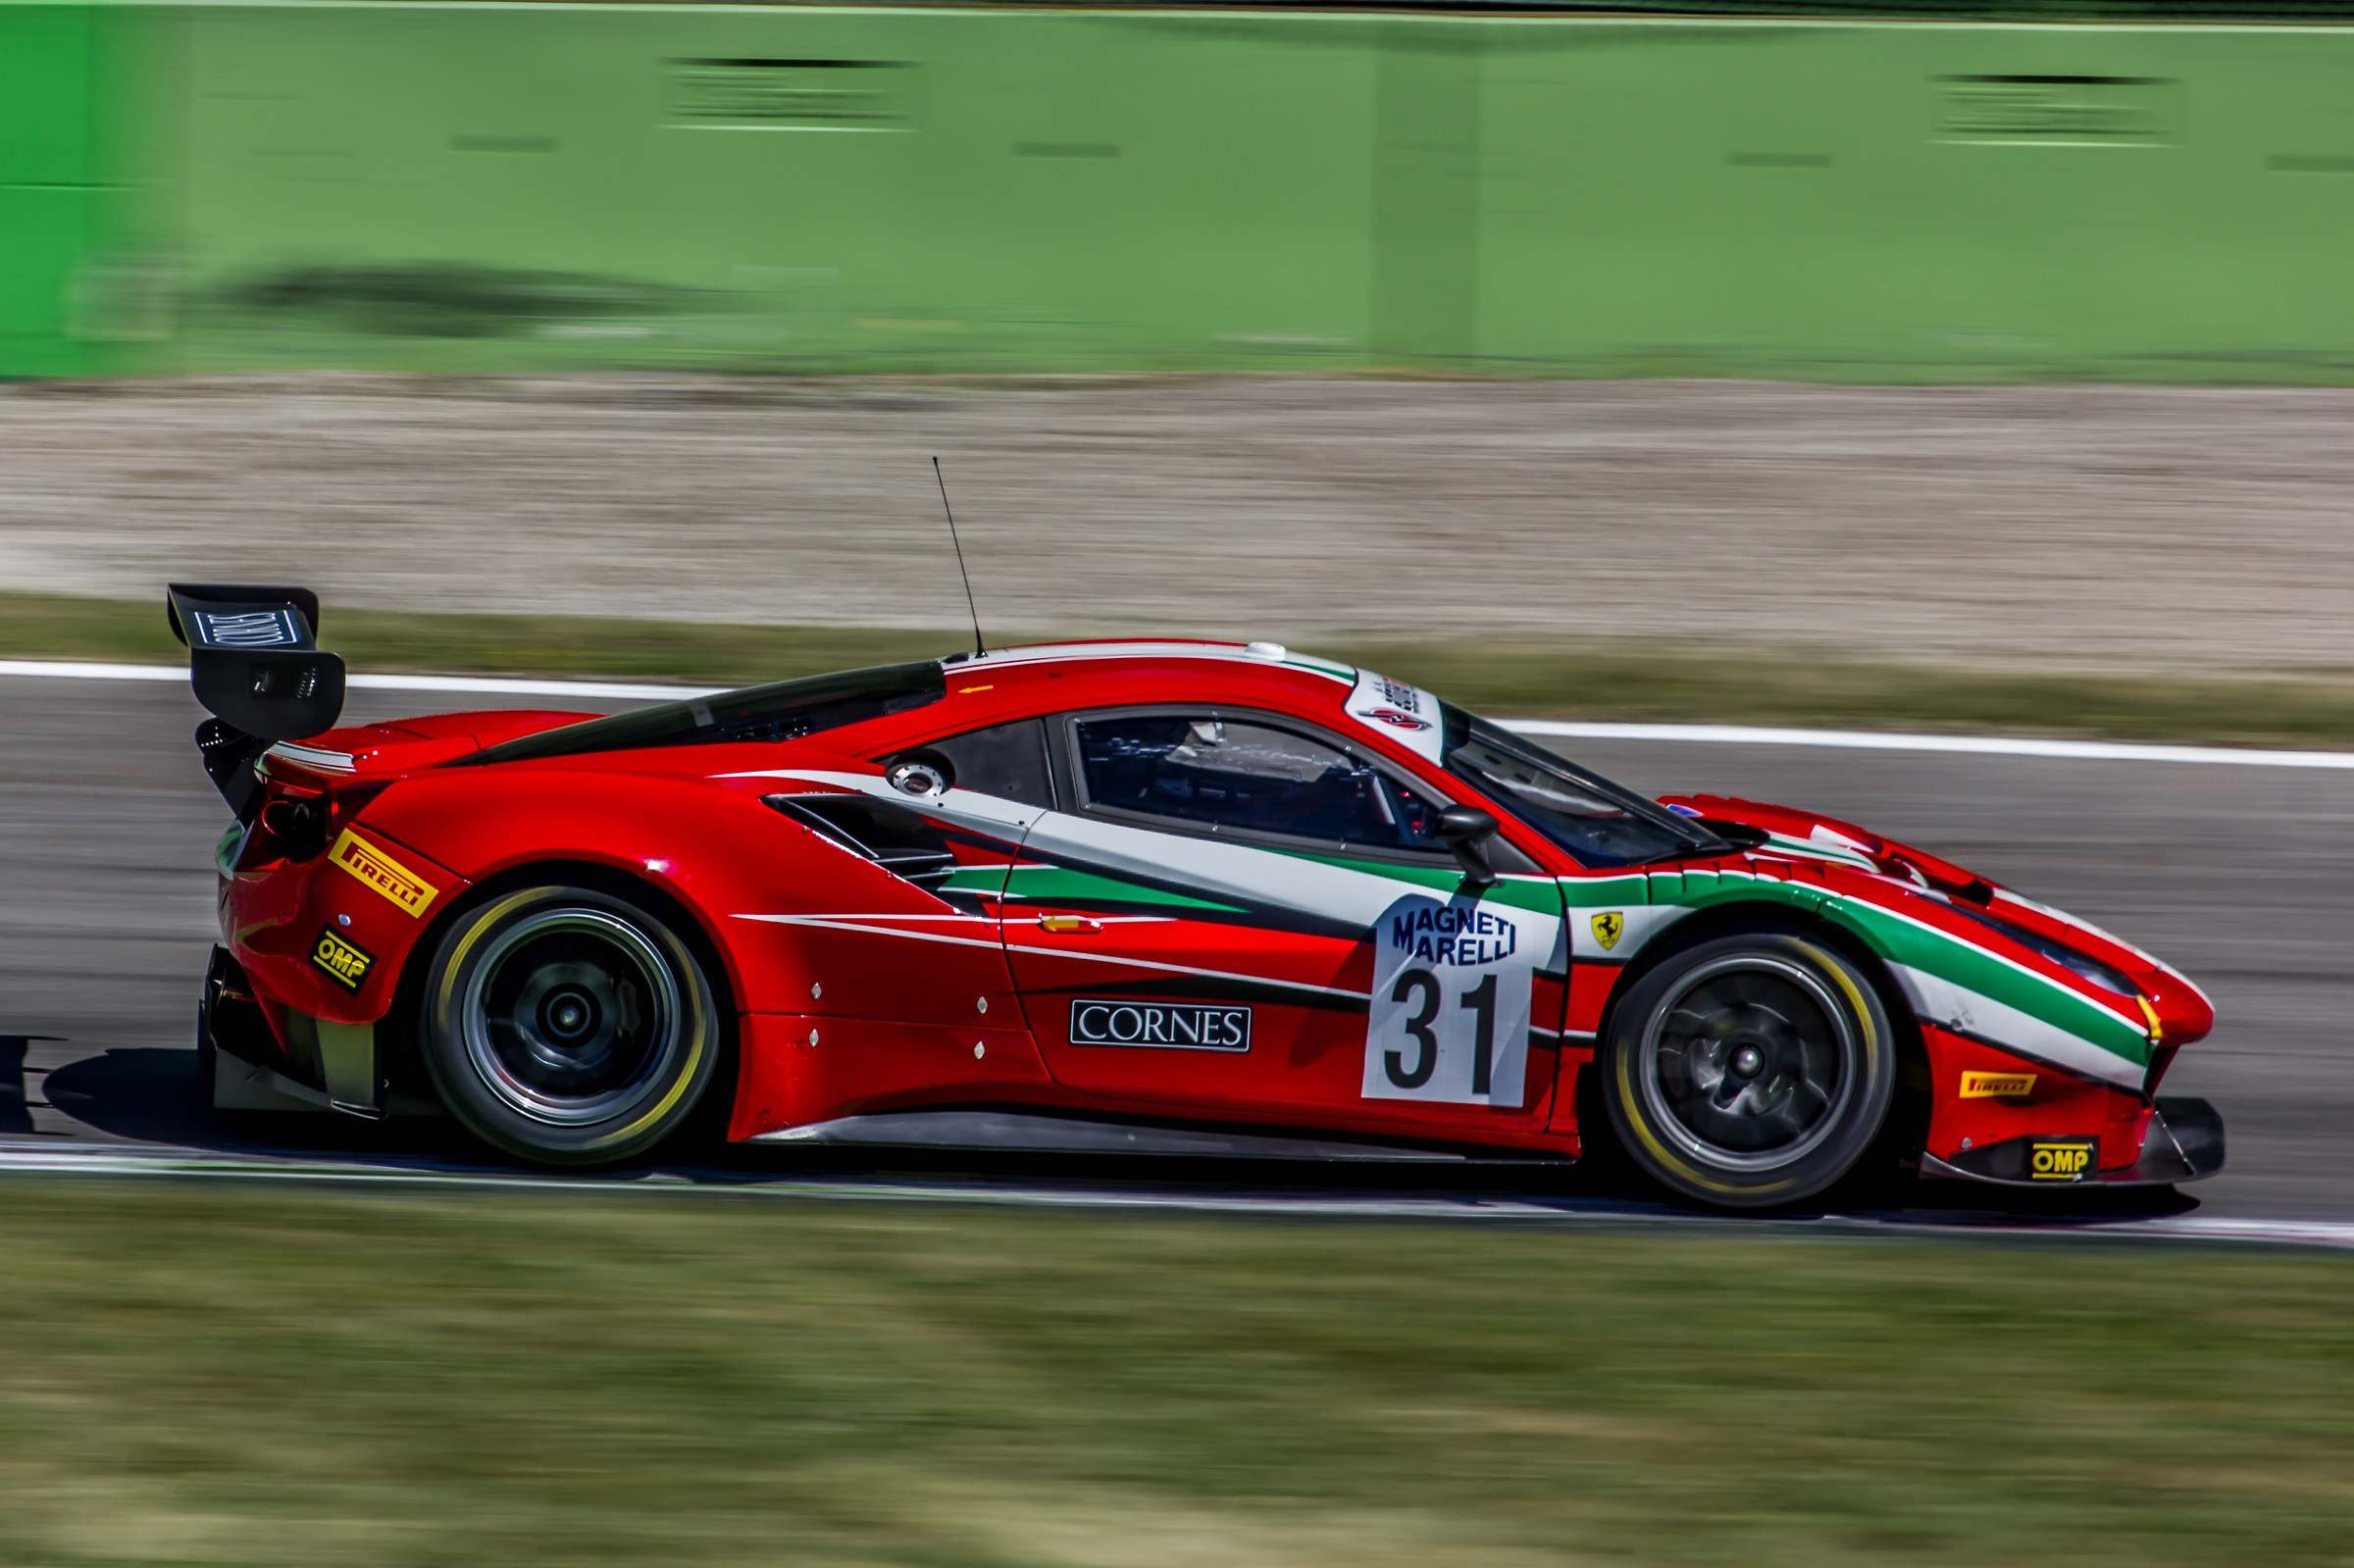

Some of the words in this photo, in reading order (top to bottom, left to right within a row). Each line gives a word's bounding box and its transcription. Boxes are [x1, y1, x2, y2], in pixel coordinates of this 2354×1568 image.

[340, 840, 425, 906] PIRELLI
[1393, 907, 1516, 949] MAGNETI
[1393, 924, 1516, 966] MARELLI
[318, 938, 366, 978] OMP
[1079, 1006, 1243, 1045] CORNES
[1384, 968, 1498, 1094] 31
[1969, 1078, 2028, 1091] PIRELLI
[2033, 1149, 2089, 1172] OMP
